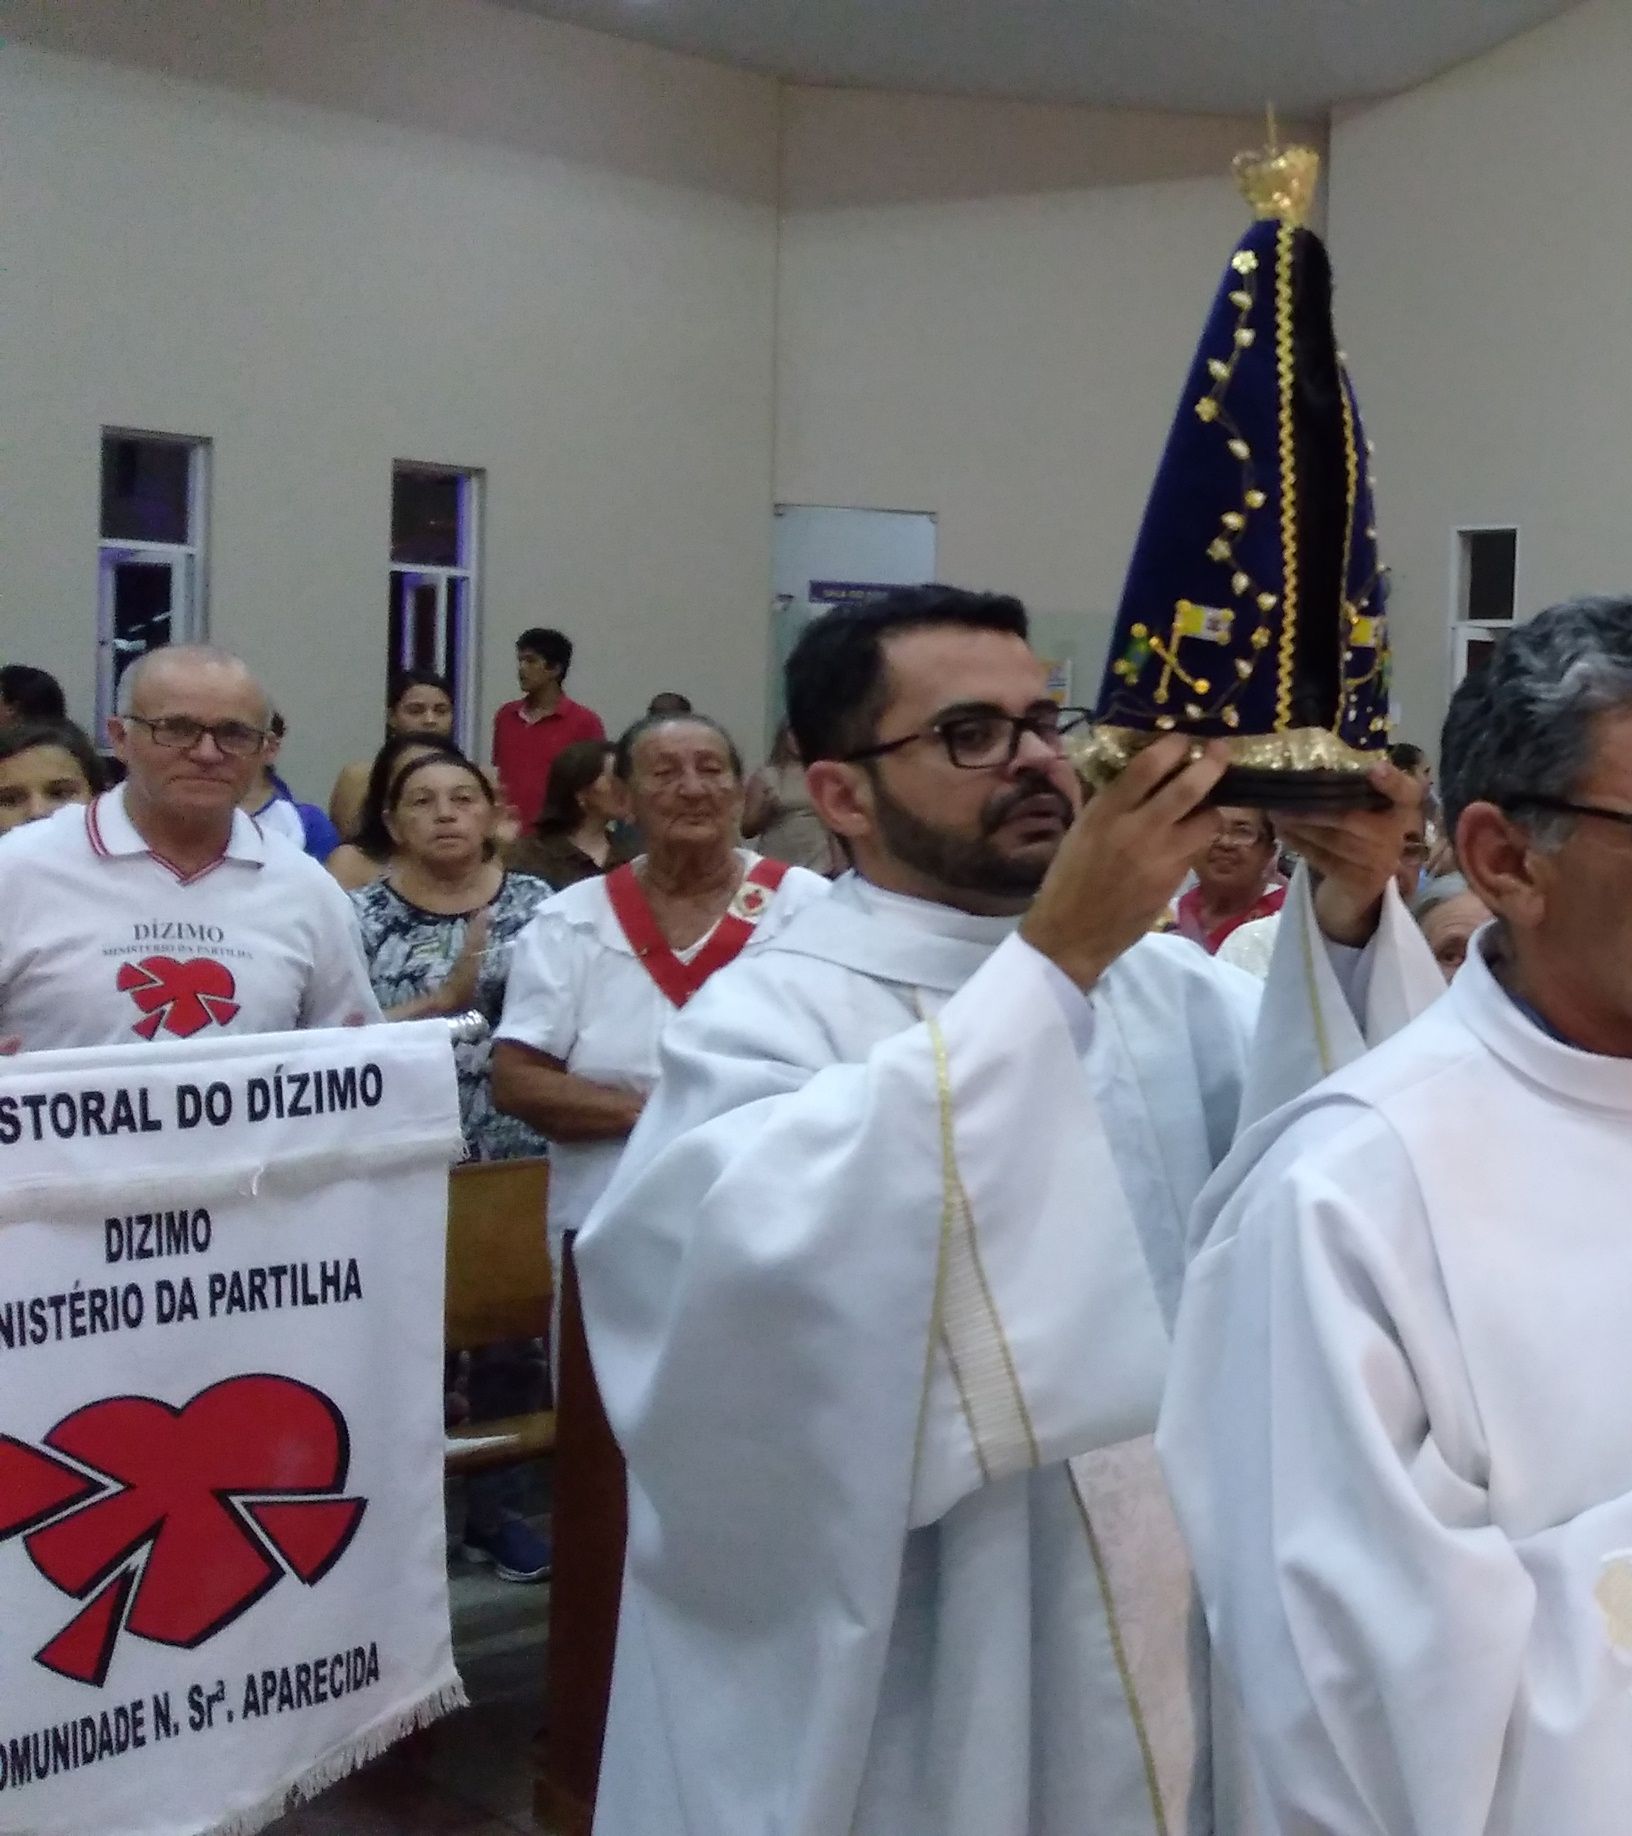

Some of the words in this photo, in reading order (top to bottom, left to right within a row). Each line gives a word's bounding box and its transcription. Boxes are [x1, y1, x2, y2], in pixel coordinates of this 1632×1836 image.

[177, 1081, 233, 1129] DO
[247, 1063, 383, 1123] DÍZIMO
[105, 1208, 212, 1264] DIZIMO
[155, 1277, 198, 1325] DA
[208, 1257, 363, 1318] PARTILHA
[153, 1692, 180, 1742] N.
[242, 1641, 381, 1720] APARECIDA
